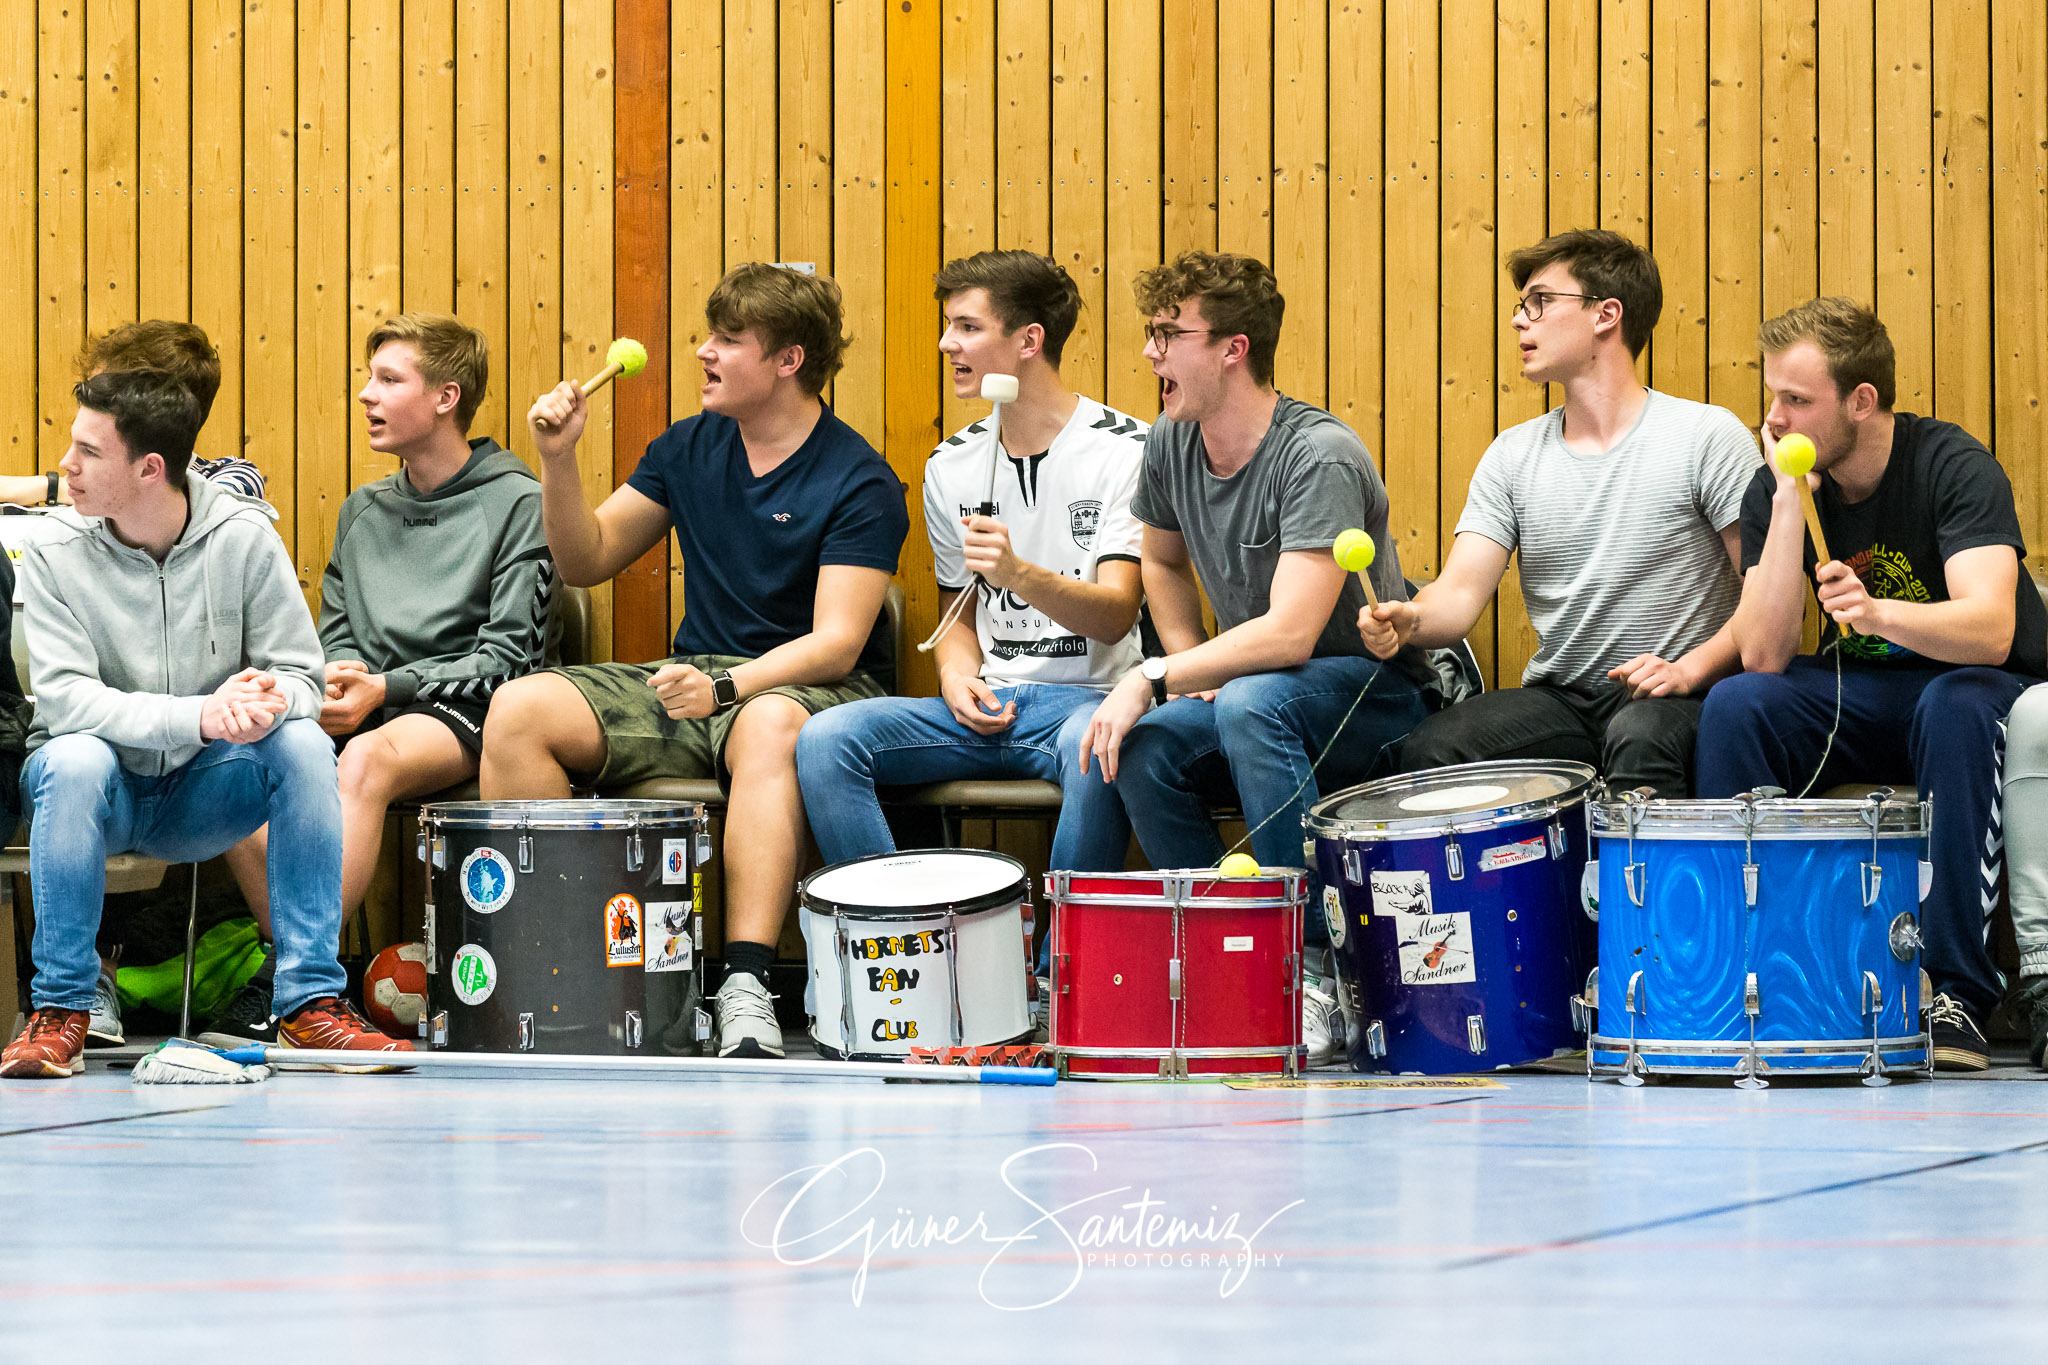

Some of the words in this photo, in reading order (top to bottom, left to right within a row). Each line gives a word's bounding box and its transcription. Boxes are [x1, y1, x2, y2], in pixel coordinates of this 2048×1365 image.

[403, 515, 437, 527] hummel
[959, 501, 999, 517] humel
[1893, 551, 1912, 573] CUP
[433, 701, 481, 734] hummel
[655, 901, 690, 927] Musik
[1408, 914, 1457, 940] Musik
[850, 928, 946, 961] HORNETS
[647, 948, 689, 972] Sandner
[867, 966, 920, 992] FAN
[1404, 961, 1467, 984] Sandner
[871, 1018, 918, 1042] CLUB
